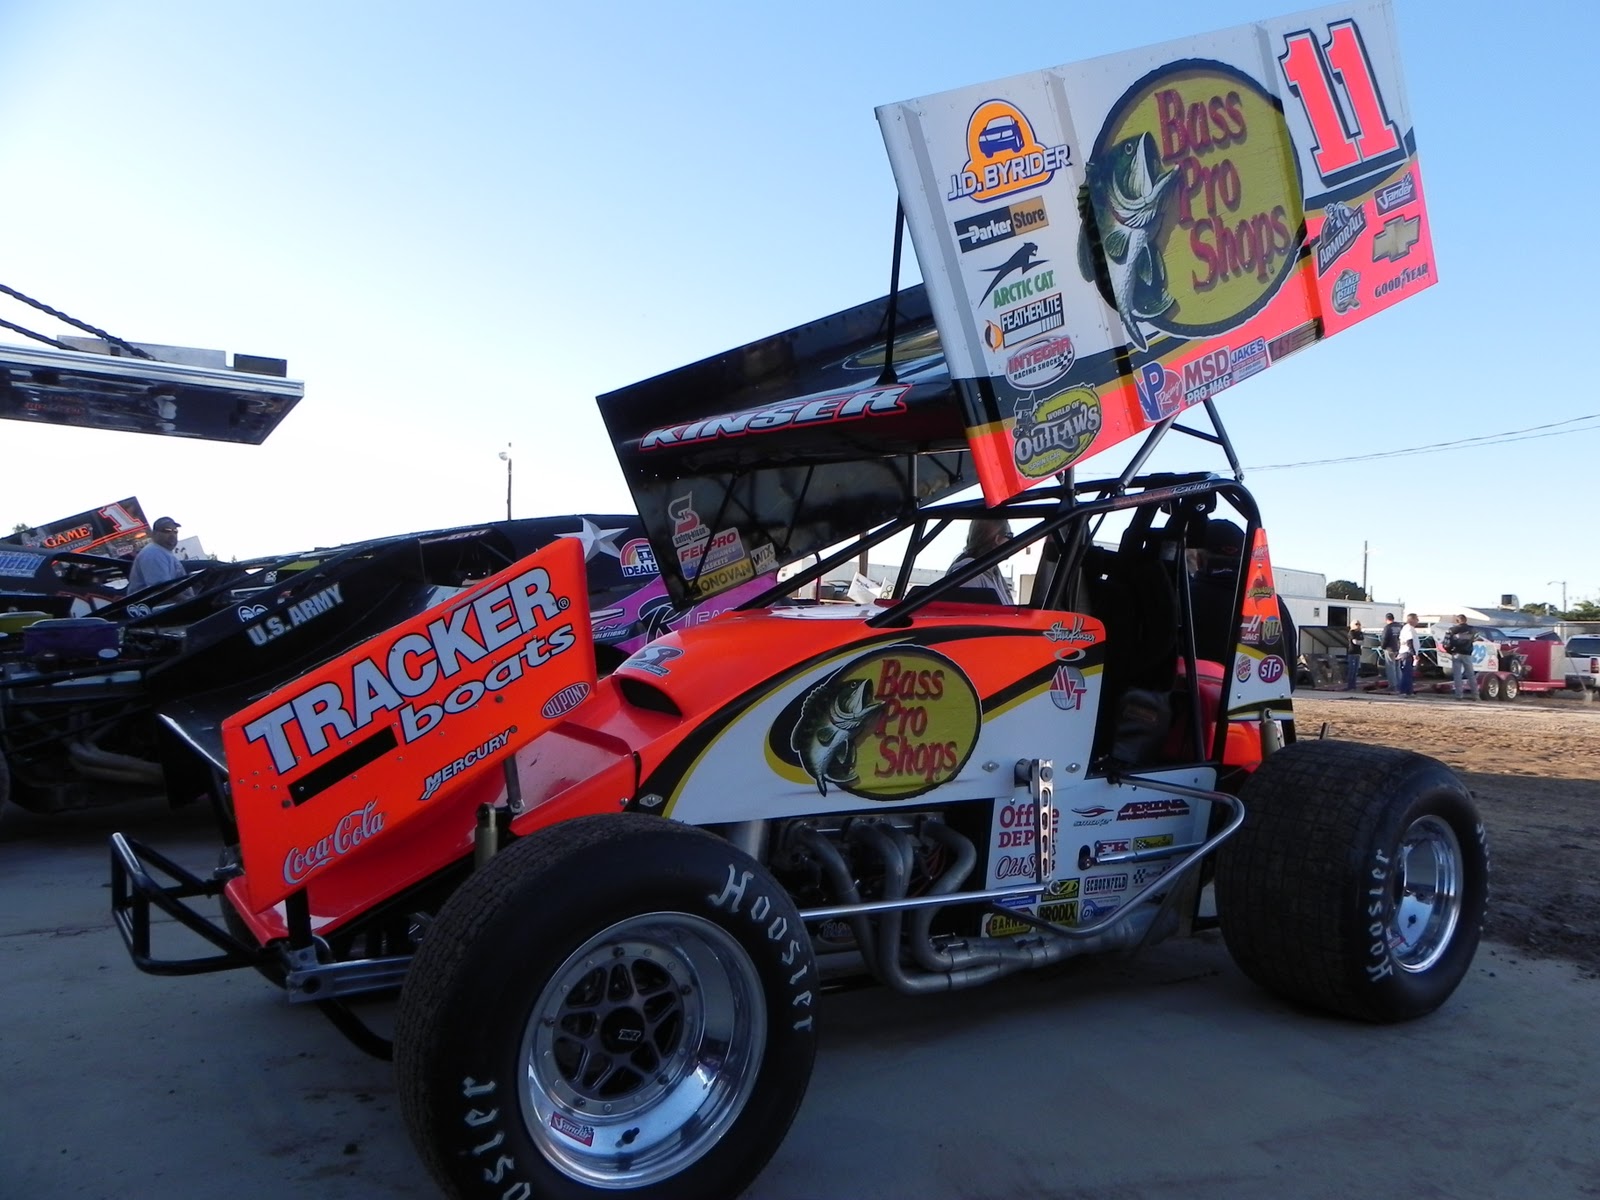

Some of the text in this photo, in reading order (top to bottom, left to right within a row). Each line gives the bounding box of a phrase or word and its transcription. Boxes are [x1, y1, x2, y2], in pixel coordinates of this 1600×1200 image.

[1280, 20, 1402, 178] 11
[1155, 89, 1247, 164] Bass
[948, 144, 1073, 201] J.D. BYRIDER
[1178, 156, 1241, 229] Pro
[967, 208, 1045, 244] Parker Store
[1190, 205, 1291, 292] Shops
[993, 270, 1054, 309] ARCTIC CAT
[1336, 273, 1359, 291] QUAKER
[1337, 284, 1357, 301] STATE
[1002, 294, 1061, 331] FEATHERLITE
[1008, 337, 1071, 374] INTEGRA
[1013, 356, 1062, 381] RACING SHOCKS
[1184, 347, 1230, 392] MSD
[1231, 339, 1264, 364] JAKE'S
[640, 386, 911, 450] KINSER
[1047, 400, 1081, 421] WORLD OF
[98, 502, 144, 533] 1
[44, 527, 90, 548] GAME
[752, 545, 774, 566] WIX
[247, 582, 345, 647] U.S. ARMY
[1262, 619, 1281, 641] RITZ
[245, 567, 558, 776] TRACKER
[401, 624, 576, 745] boats
[874, 659, 945, 700] Bass
[1261, 659, 1281, 679] STP
[874, 699, 928, 739] Pro
[420, 729, 510, 800] MERCURY
[874, 735, 957, 783] Shops
[1086, 875, 1127, 892] SCHOENFELD
